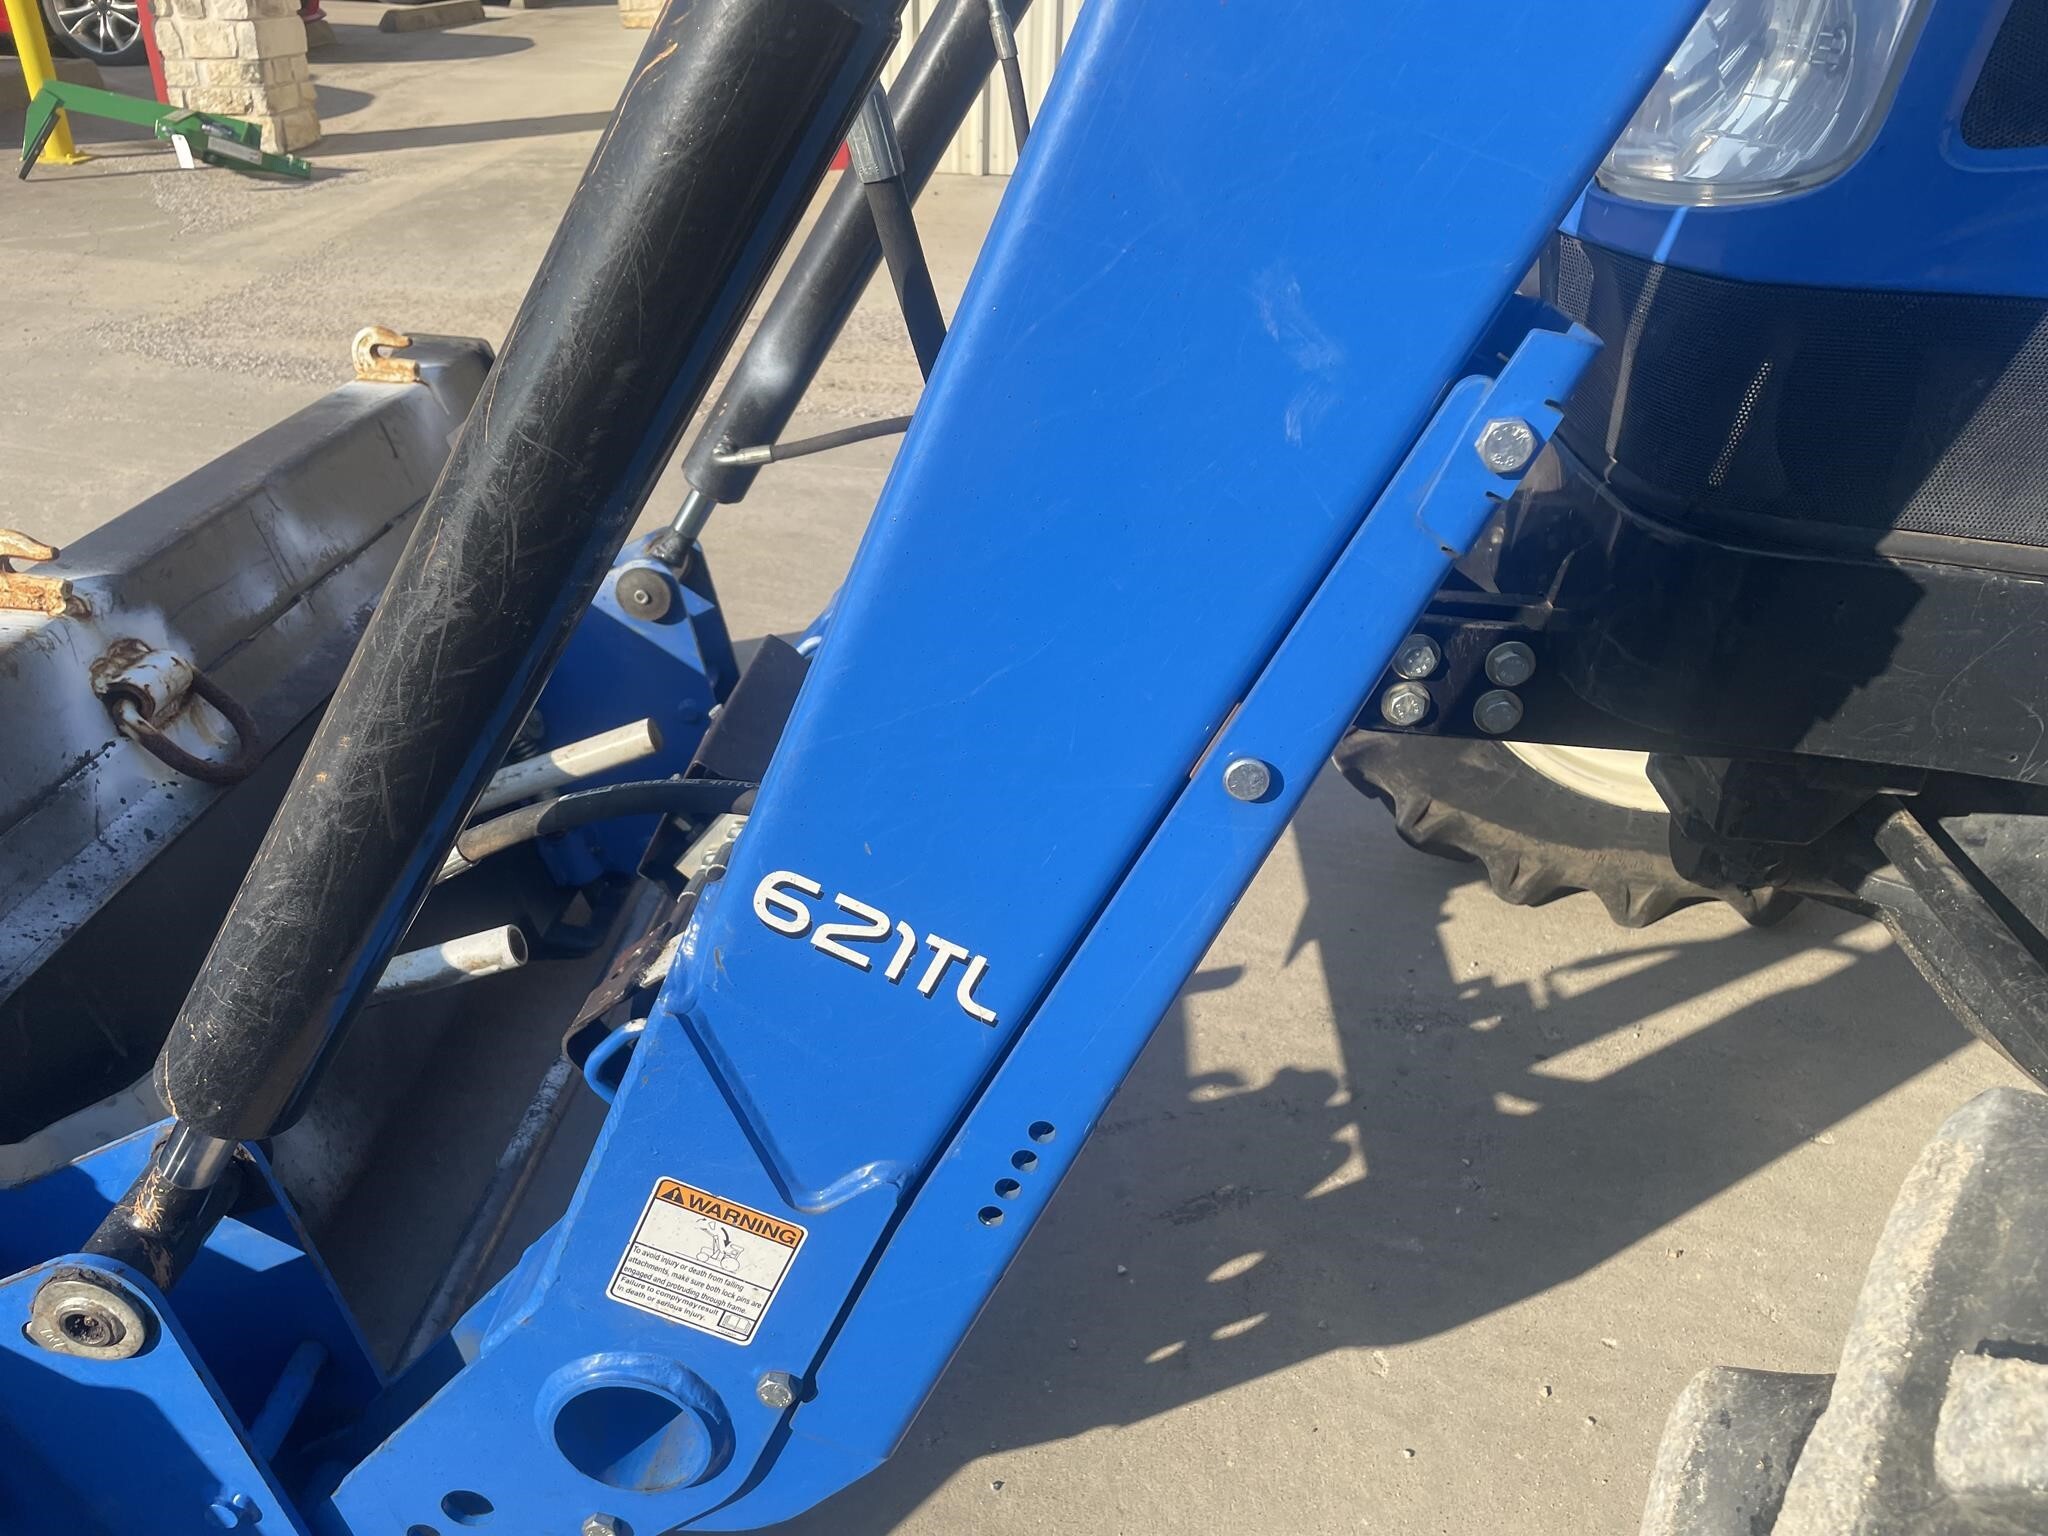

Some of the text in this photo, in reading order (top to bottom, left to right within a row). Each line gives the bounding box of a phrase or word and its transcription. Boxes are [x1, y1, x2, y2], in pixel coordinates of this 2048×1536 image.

[753, 871, 998, 1028] 621TL
[689, 1194, 797, 1245] WARNING
[633, 1246, 641, 1254] To
[642, 1250, 660, 1261] avoid
[661, 1254, 679, 1269] injury
[688, 1265, 707, 1278] death
[708, 1273, 723, 1284] from
[621, 1277, 645, 1290] Failure
[656, 1289, 683, 1304] comply
[682, 1298, 697, 1309] may
[698, 1303, 719, 1315] result
[624, 1266, 652, 1281] engaged
[653, 1274, 665, 1285] and
[666, 1279, 699, 1299] protruding
[701, 1291, 726, 1308] through
[625, 1288, 645, 1299] death
[656, 1298, 683, 1312] serious
[671, 1272, 689, 1283] make
[690, 1279, 704, 1288] sure
[705, 1283, 721, 1293] both
[722, 1287, 736, 1299] lock
[736, 1294, 750, 1304] pins
[751, 1300, 761, 1309] are
